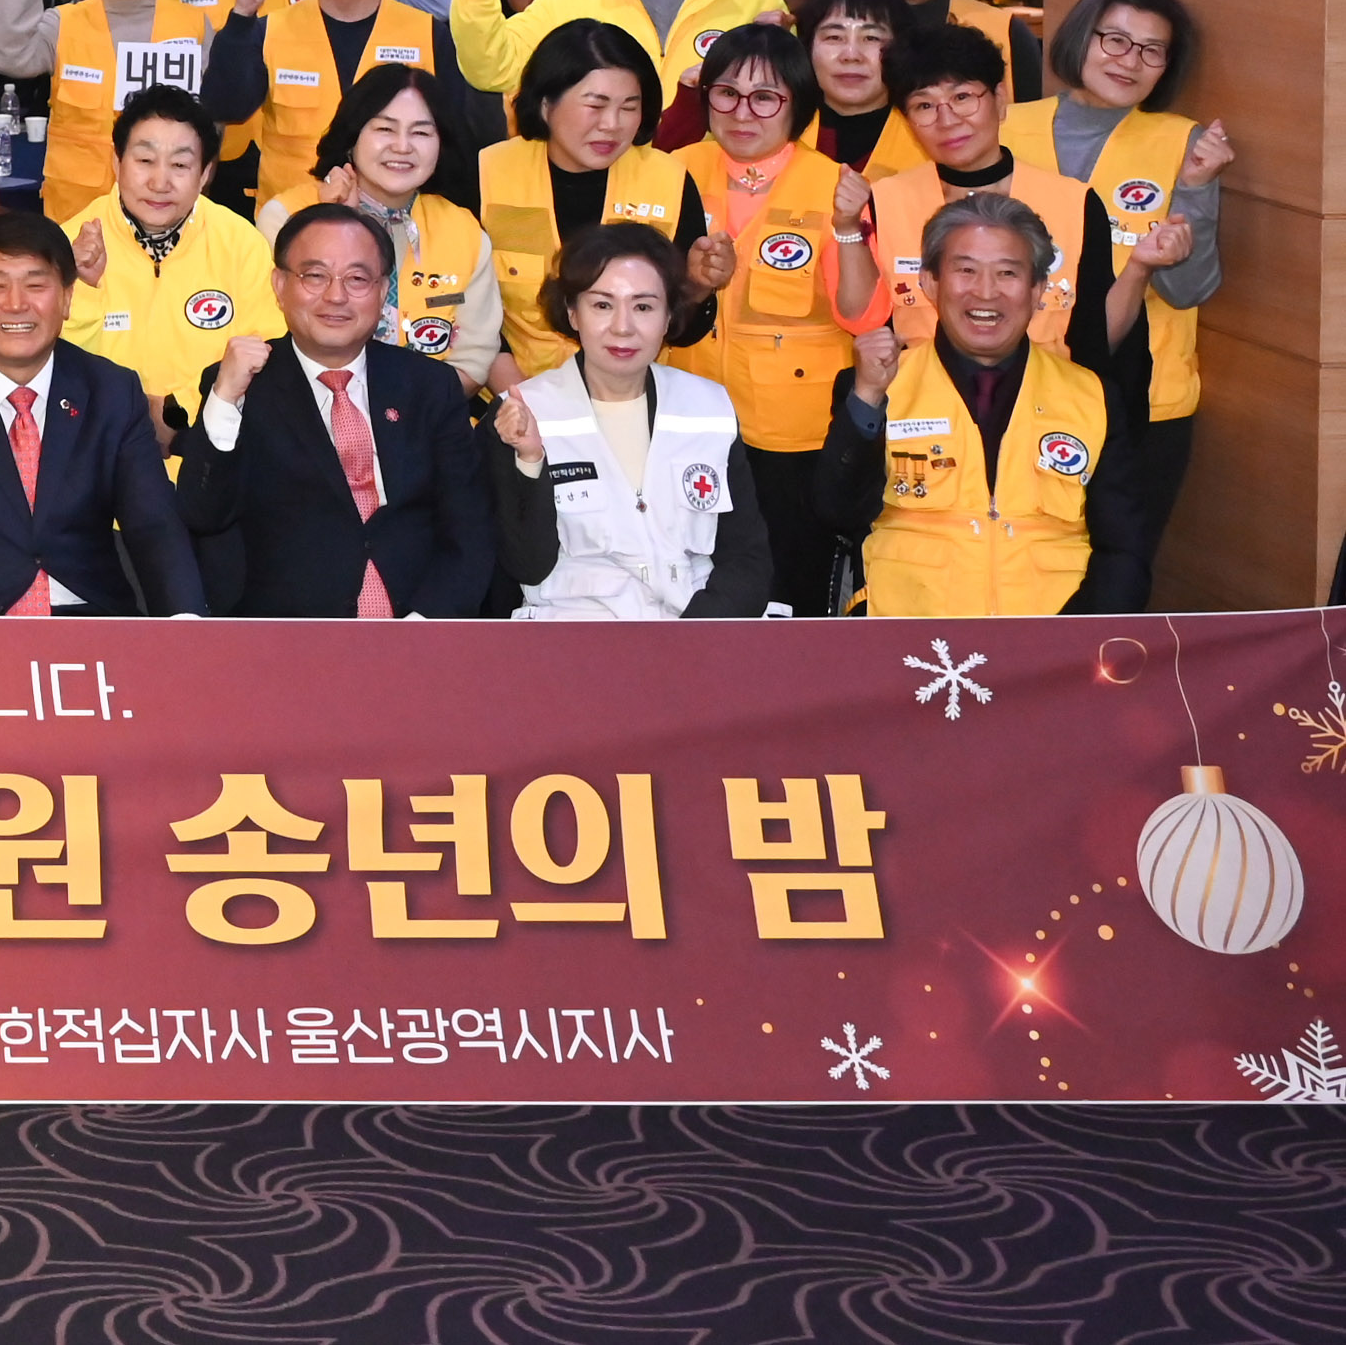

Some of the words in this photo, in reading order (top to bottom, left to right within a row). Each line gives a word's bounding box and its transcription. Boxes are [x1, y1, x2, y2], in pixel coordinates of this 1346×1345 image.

[165, 773, 667, 945] 송년의
[722, 774, 886, 939] 밤
[285, 1007, 674, 1064] 울산광역시지사
